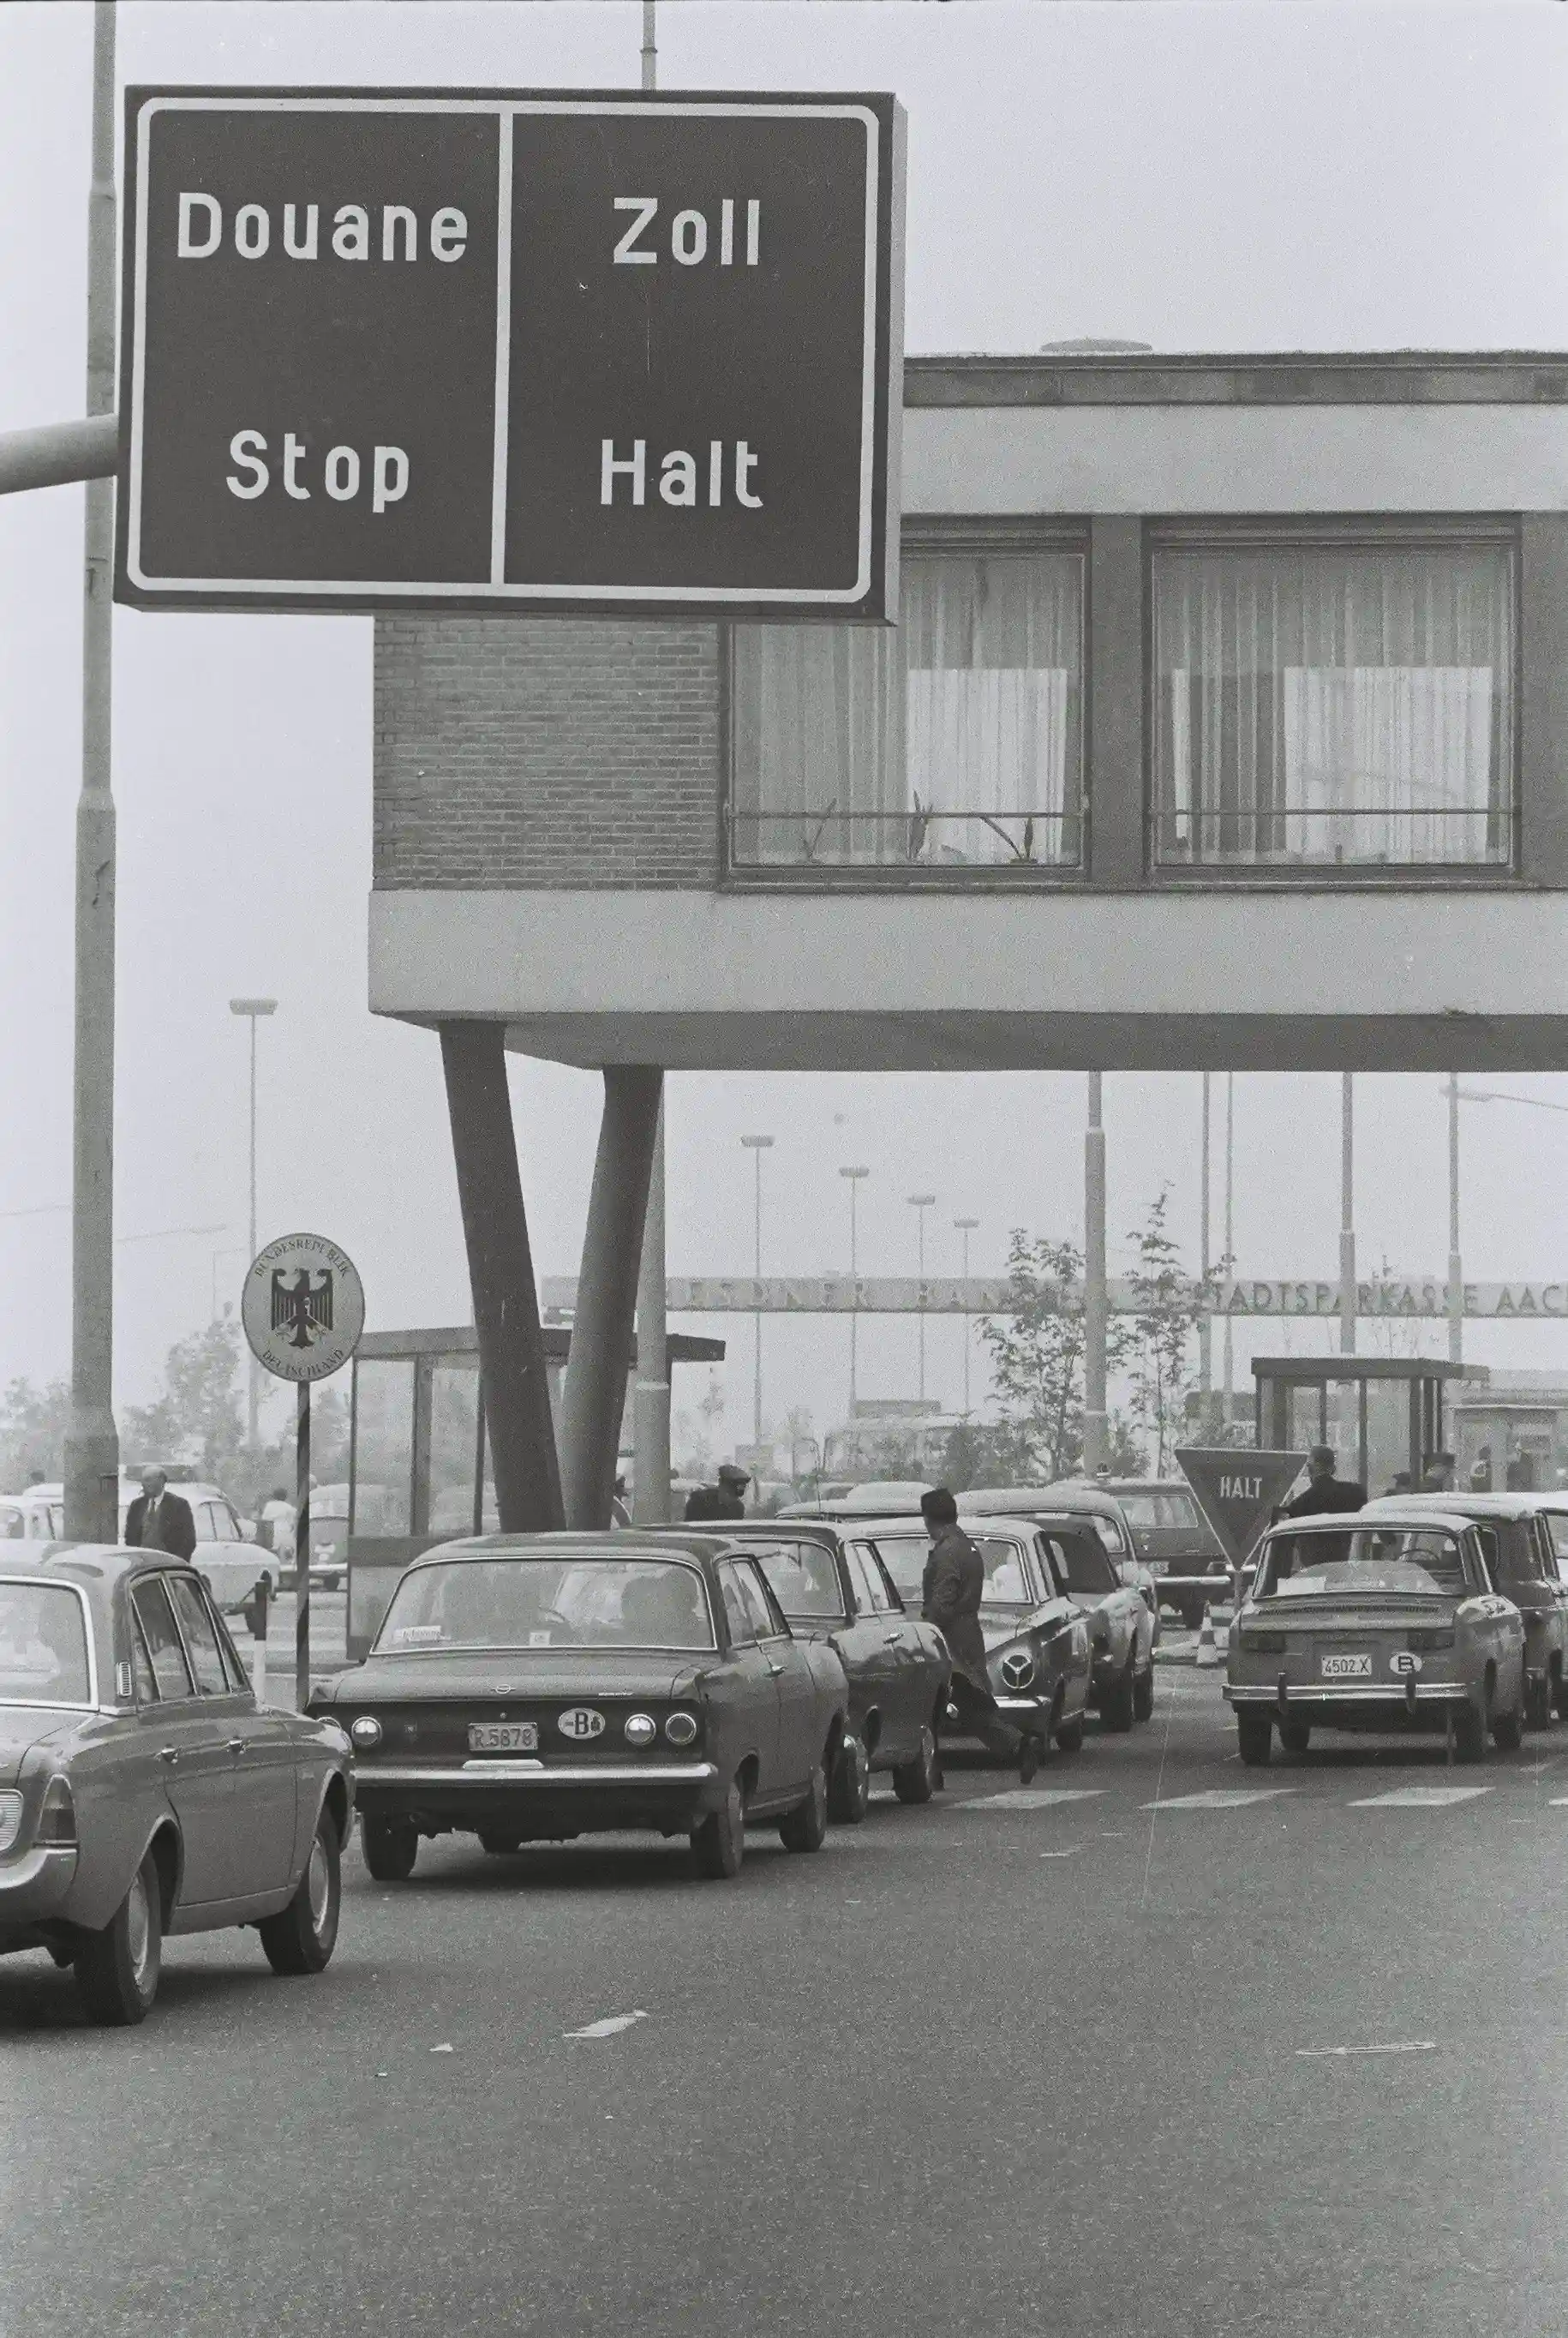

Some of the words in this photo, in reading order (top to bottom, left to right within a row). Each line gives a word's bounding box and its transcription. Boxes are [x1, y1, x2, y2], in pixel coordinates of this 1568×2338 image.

[177, 191, 469, 263] Douane
[612, 196, 761, 267] Zoll
[225, 429, 411, 514] Stop
[600, 438, 764, 509] Halt
[1190, 1284, 1478, 1313] TADTSPRKASE
[1495, 1285, 1568, 1312] AAC
[1220, 1476, 1263, 1498] HALT
[1398, 1655, 1415, 1672] B
